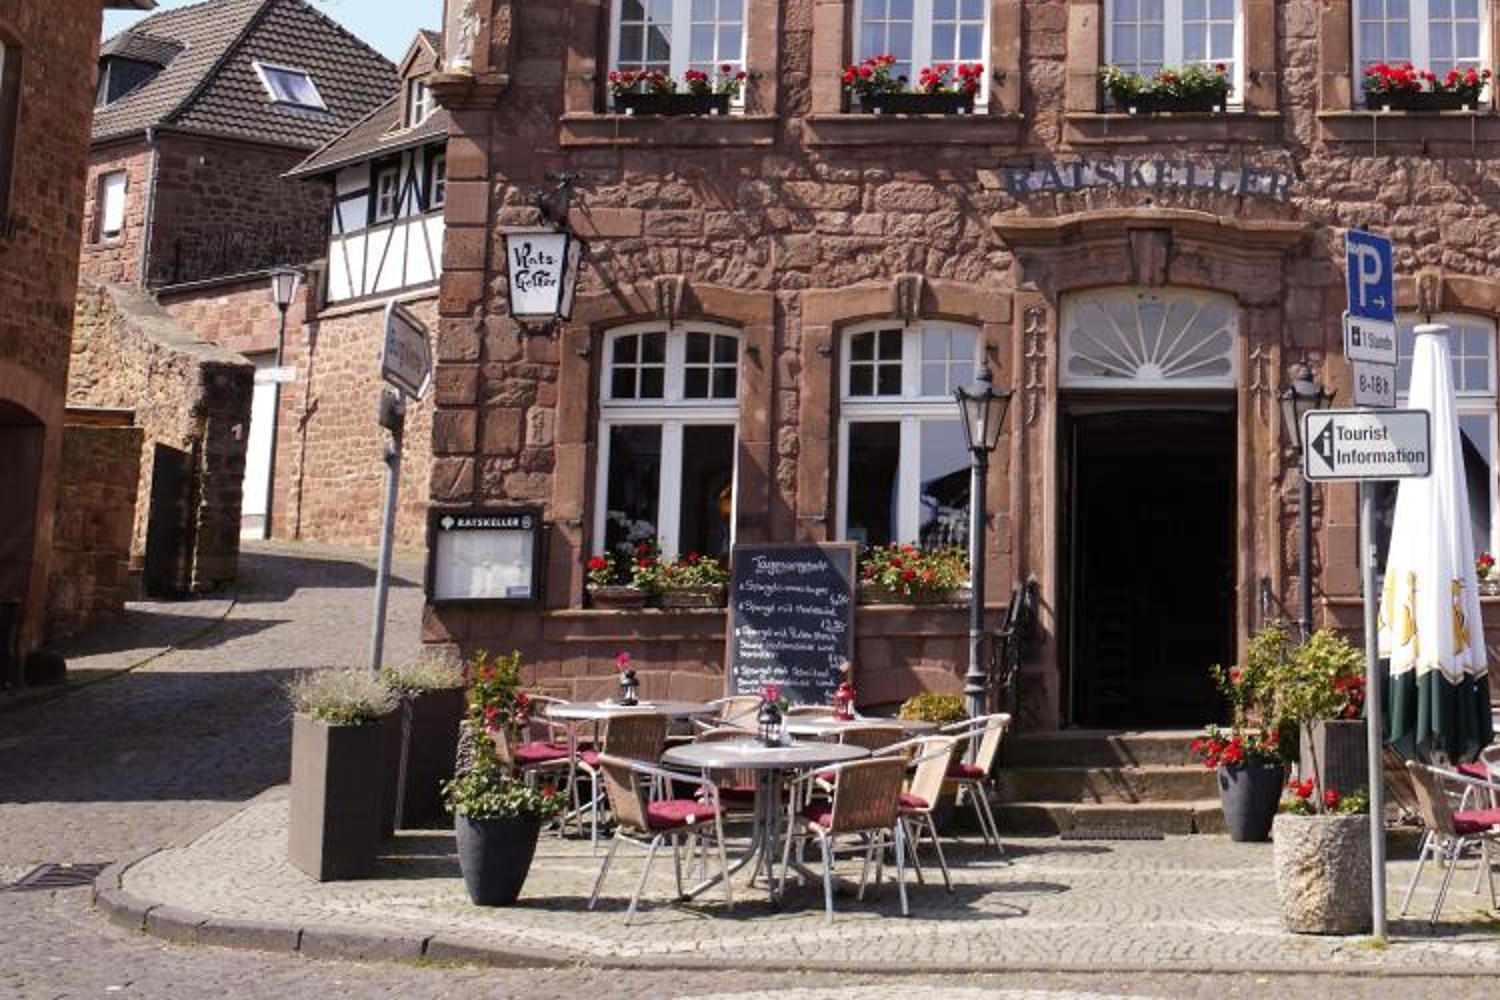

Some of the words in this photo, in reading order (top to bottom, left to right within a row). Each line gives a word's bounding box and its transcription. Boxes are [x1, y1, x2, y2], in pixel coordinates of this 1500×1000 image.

[1003, 158, 1293, 202] RATSKELLER
[1357, 243, 1382, 307] P
[1336, 425, 1388, 441] Tourist
[1337, 449, 1425, 465] Information
[457, 518, 519, 527] RATSKELLER
